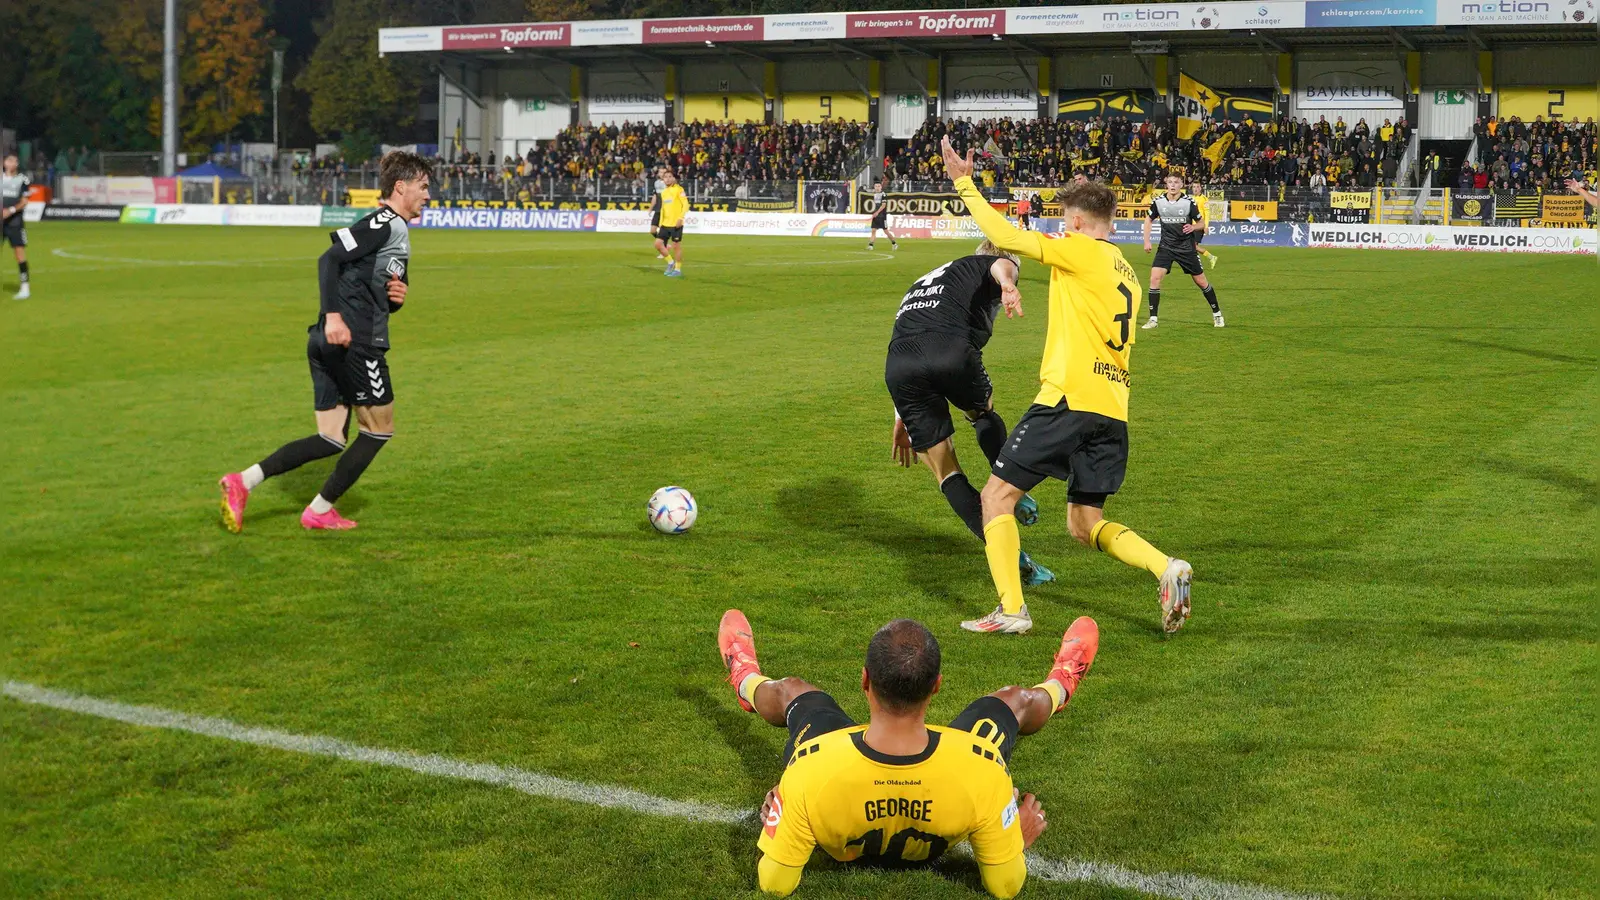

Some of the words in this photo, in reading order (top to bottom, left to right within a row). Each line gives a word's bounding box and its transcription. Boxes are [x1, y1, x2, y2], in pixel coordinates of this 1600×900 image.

[1321, 7, 1424, 18] schlaeger.com/karriere
[1462, 1, 1549, 13] motion
[1015, 13, 1079, 21] Formentechnik
[1103, 8, 1179, 20] motion
[918, 14, 997, 32] Topform!
[1245, 17, 1281, 25] schlaeger
[650, 23, 754, 34] formentechnik-bayreuth.de
[500, 27, 564, 44] Topform!
[719, 80, 728, 90] M
[1103, 75, 1112, 86] N
[953, 88, 1030, 103] BAYREUTH
[1306, 84, 1396, 102] BAYREUTH
[820, 96, 832, 118] 9
[1548, 90, 1564, 117] 2
[422, 209, 501, 228] FRANKEN
[501, 210, 582, 229] BRUNNEN
[703, 218, 780, 230] hagebaumarkt
[896, 218, 932, 228] FARBE
[935, 219, 951, 229] IST
[955, 220, 979, 230] UNS
[931, 230, 985, 238] www.swcolo
[1220, 225, 1236, 234] AM
[1240, 225, 1276, 234] BALL!
[1311, 231, 1422, 244] WEDLICH.COM
[1453, 234, 1570, 248] WEDLICH.COM
[1105, 281, 1133, 352] 3
[864, 798, 933, 822] GEORGE
